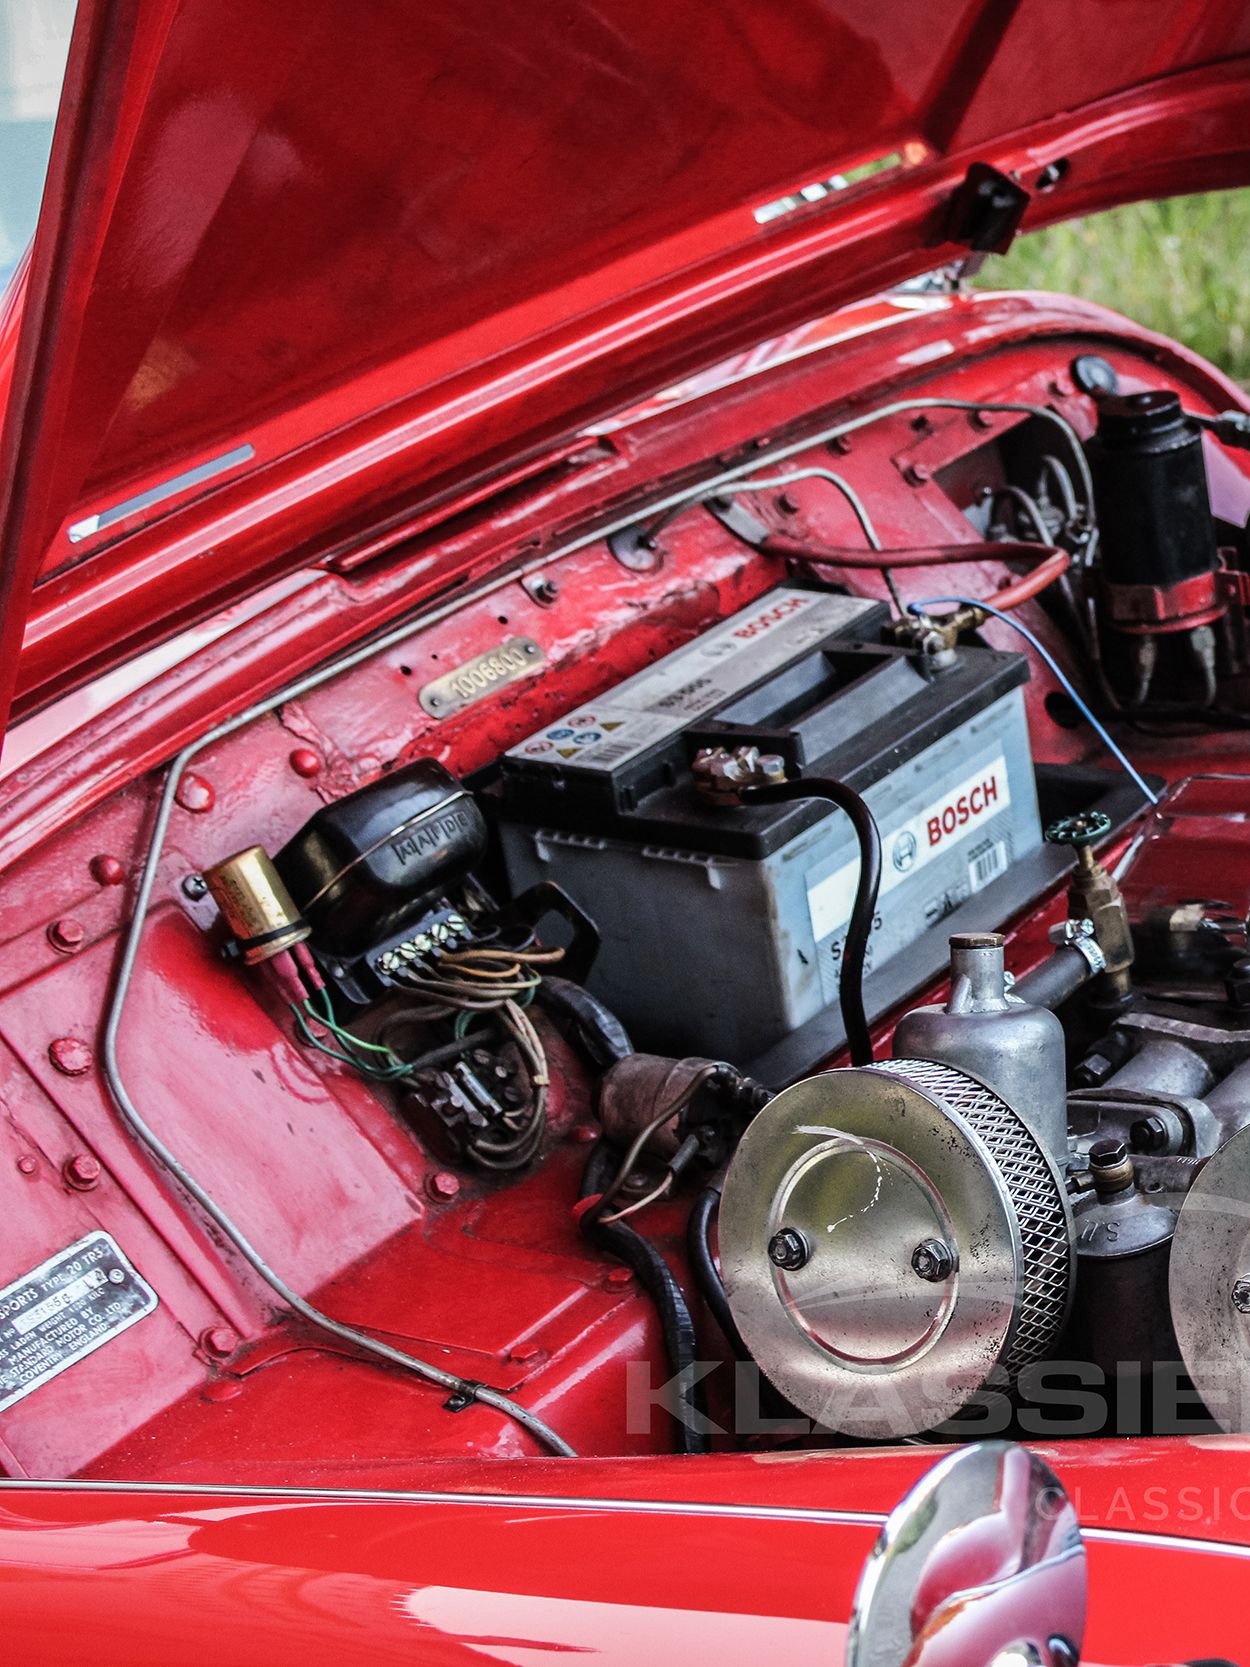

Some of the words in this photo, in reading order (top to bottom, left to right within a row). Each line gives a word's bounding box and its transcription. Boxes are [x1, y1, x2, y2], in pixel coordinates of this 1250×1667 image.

[926, 775, 998, 847] BOSCH
[41, 1274, 65, 1291] TYPE
[66, 1261, 82, 1274] 20
[8, 1318, 79, 1365] MANUFACTURED
[80, 1307, 95, 1319] BY
[9, 1345, 54, 1377] STANDARD
[55, 1324, 88, 1347] MOTOR
[10, 1330, 37, 1350] LADEN
[37, 1312, 66, 1332] WEIGHT
